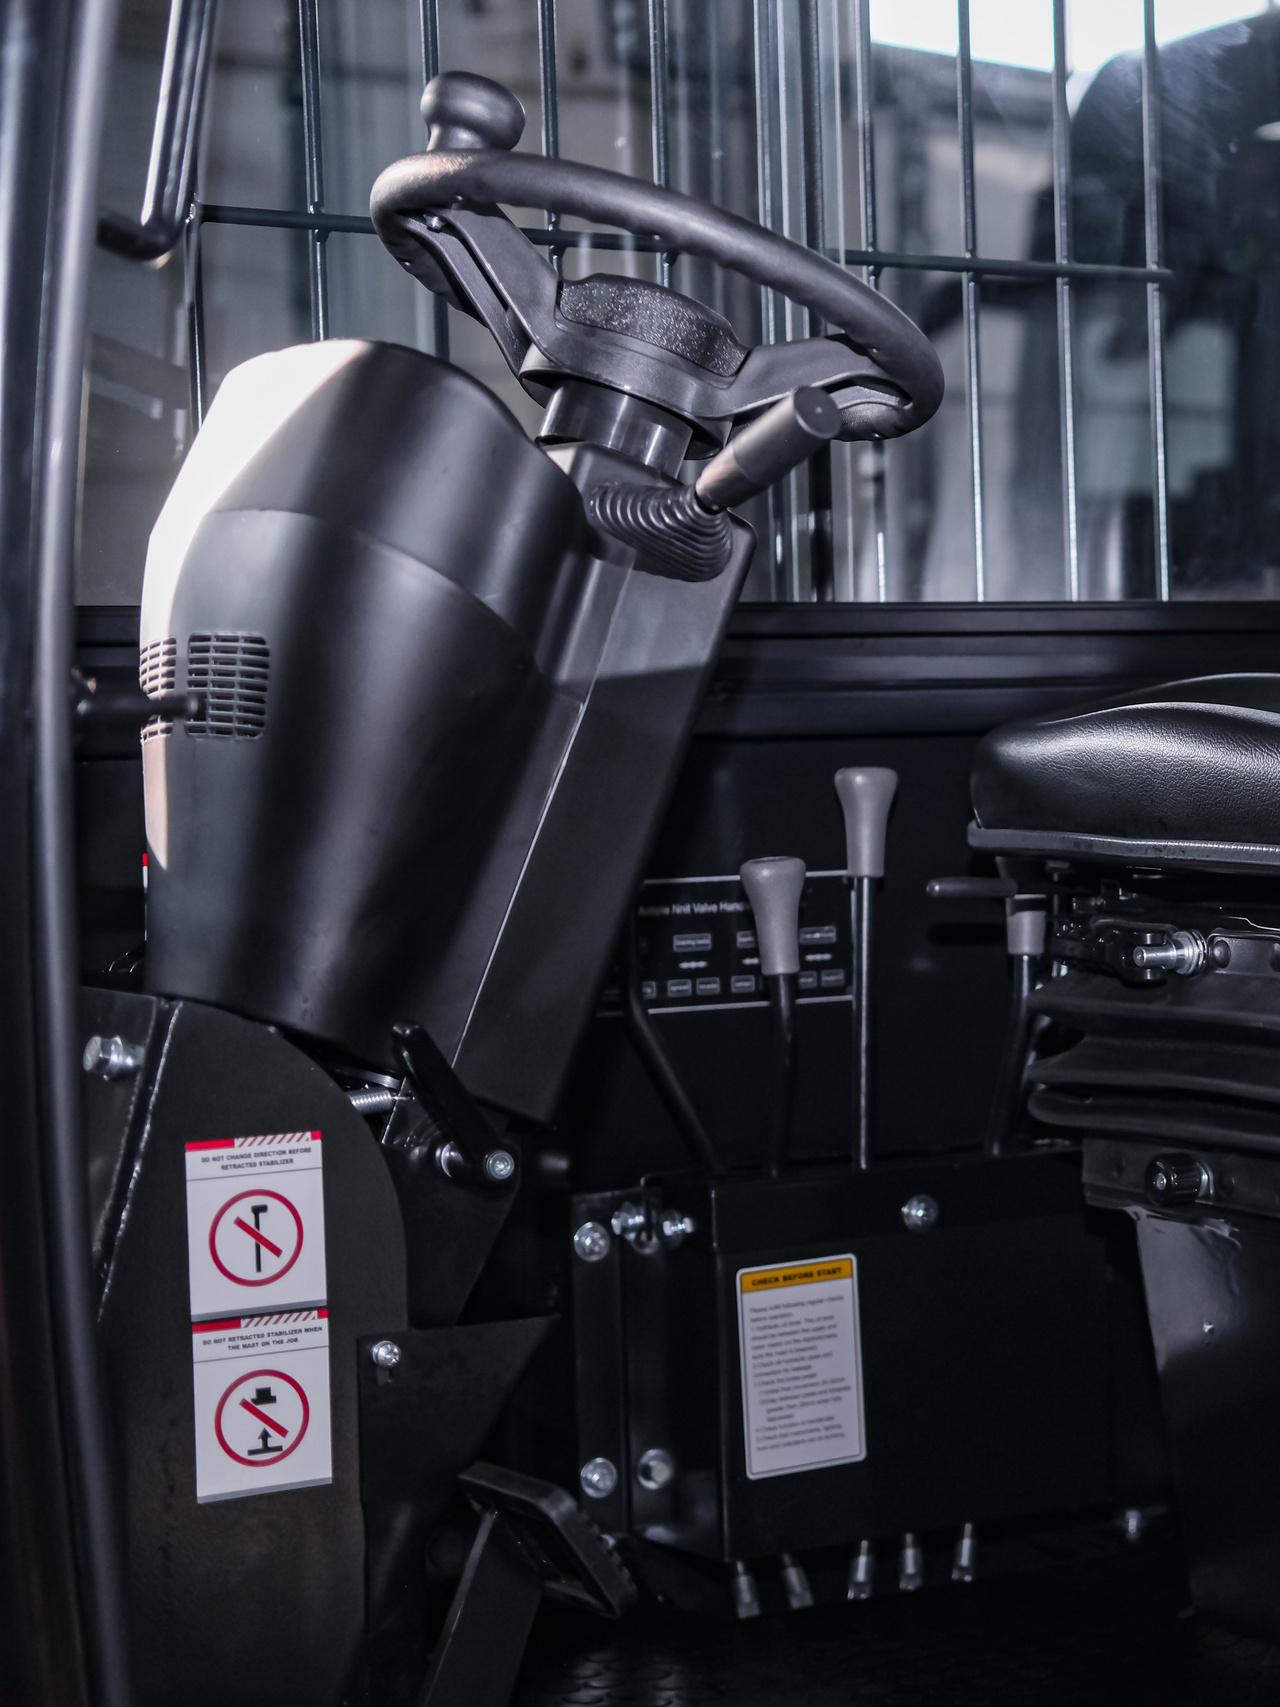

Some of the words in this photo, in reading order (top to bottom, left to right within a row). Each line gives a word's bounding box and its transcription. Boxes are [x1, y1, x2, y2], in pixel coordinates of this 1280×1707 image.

[692, 902, 718, 914] Valve
[226, 1152, 252, 1161] CHANGE
[253, 1149, 287, 1158] DIRECTION
[288, 1147, 311, 1155] BEFORE
[221, 1161, 257, 1170] RETRACTED
[258, 1158, 294, 1167] STABILIZER
[751, 1276, 780, 1286] CHECK
[782, 1271, 814, 1281] BEFORE
[817, 1267, 842, 1277] START
[228, 1333, 265, 1342] RETRACTED
[267, 1328, 303, 1338] STABILIZER
